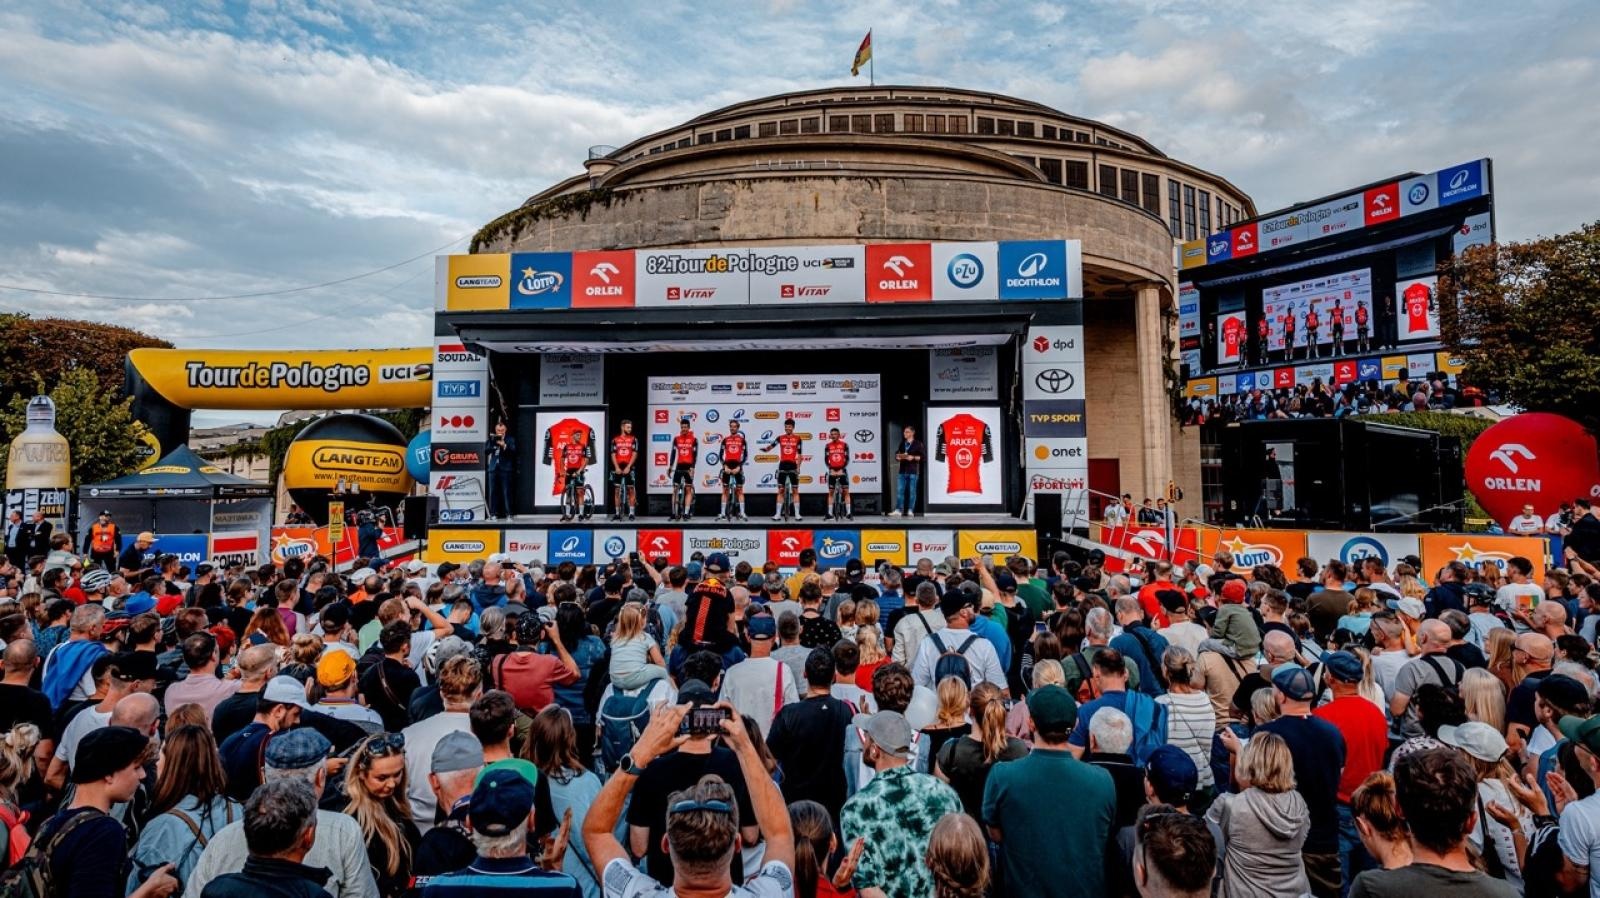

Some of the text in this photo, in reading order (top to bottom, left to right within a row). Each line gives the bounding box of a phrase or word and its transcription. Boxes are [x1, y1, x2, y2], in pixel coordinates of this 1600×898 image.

[1371, 206, 1392, 217] ORLEN
[1472, 222, 1487, 232] dpd
[803, 259, 820, 268] UCI
[955, 264, 976, 279] PZU
[527, 276, 555, 290] LOTTO
[879, 279, 918, 290] ORLEN
[1006, 277, 1060, 288] DECATHLON
[585, 286, 623, 296] ORLEN
[1053, 339, 1074, 351] dpd
[438, 353, 481, 362] SOUDAL
[382, 367, 411, 380] UCI
[470, 382, 476, 395] 1
[934, 386, 992, 394] www.poland.travel
[1030, 414, 1081, 422] TVP SPORT
[950, 438, 978, 446] ARKEA
[1052, 446, 1082, 457] onet
[319, 453, 399, 467] LANGTEAM
[1033, 481, 1084, 489] SPORTOWY
[1484, 477, 1541, 492] ORLEN
[40, 491, 65, 505] ZERO
[282, 543, 308, 555] LOTTO
[827, 544, 847, 555] LOTTO
[1235, 551, 1270, 567] LOTTO
